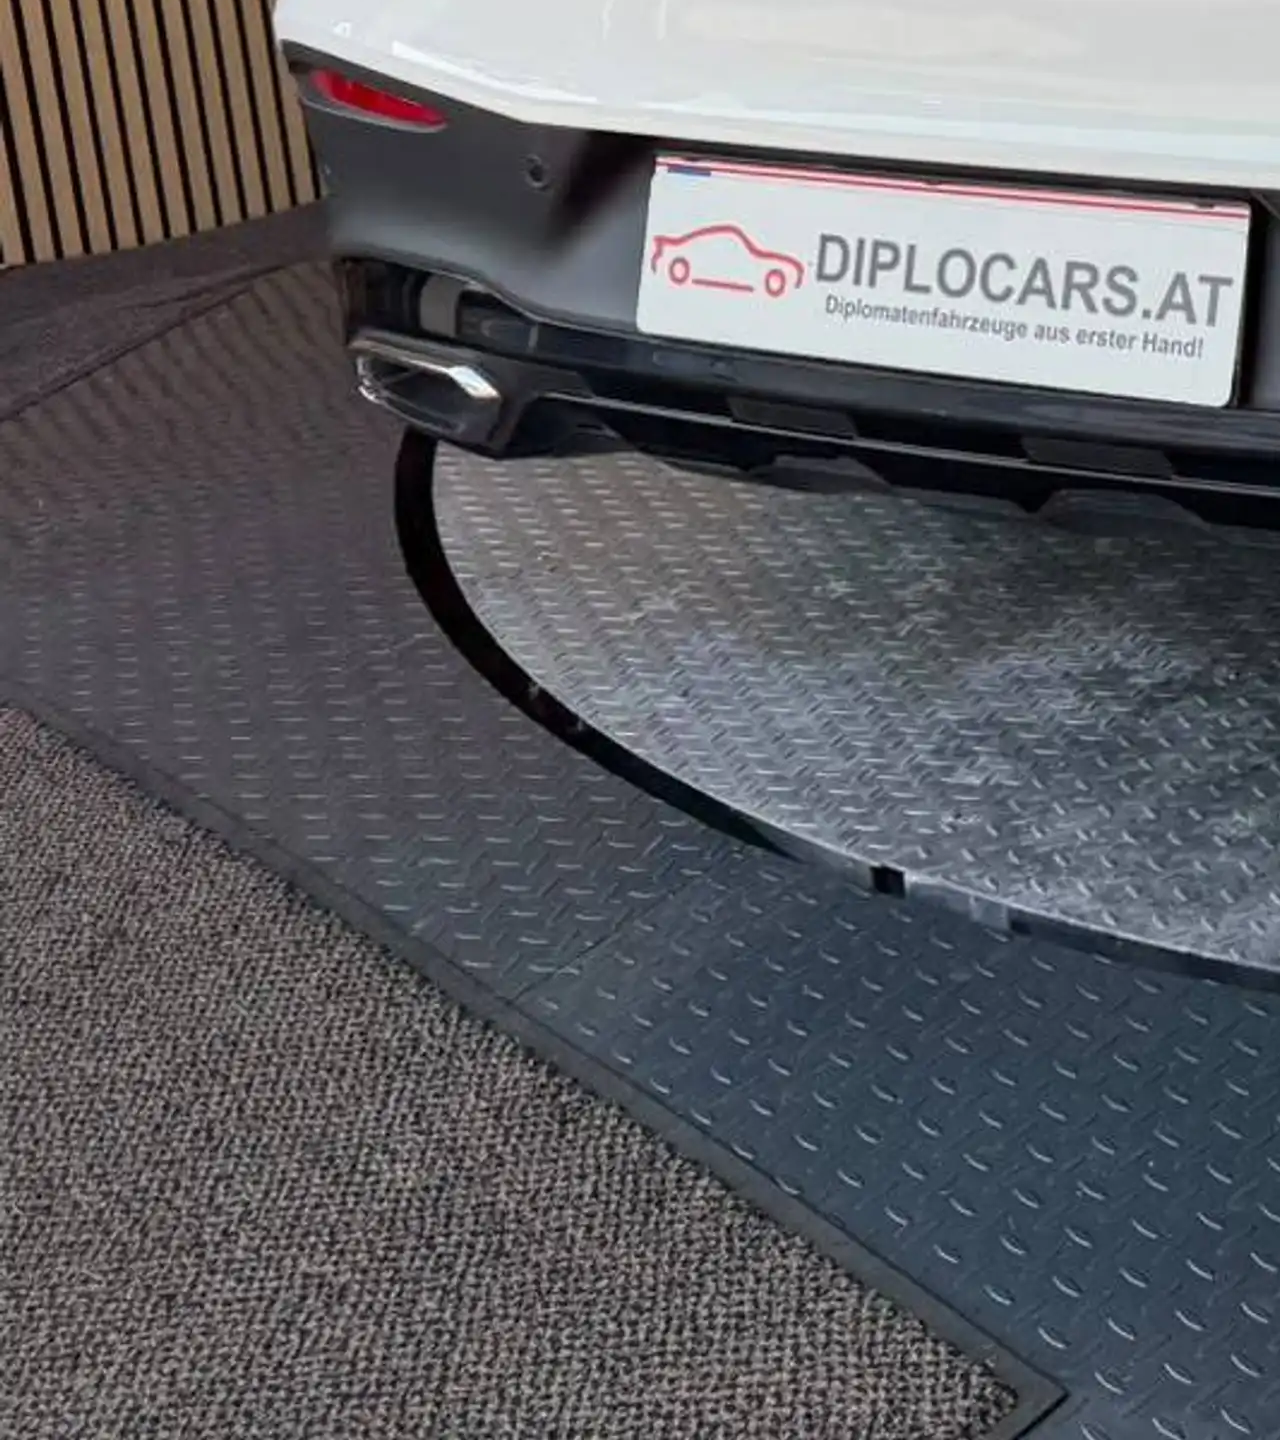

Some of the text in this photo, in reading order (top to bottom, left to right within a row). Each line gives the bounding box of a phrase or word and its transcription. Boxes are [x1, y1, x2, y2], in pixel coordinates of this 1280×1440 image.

[815, 233, 1233, 329] DIPLOCARS.AT
[824, 294, 1204, 359] Diplomatenfahrzeuge aus erster Hand!
